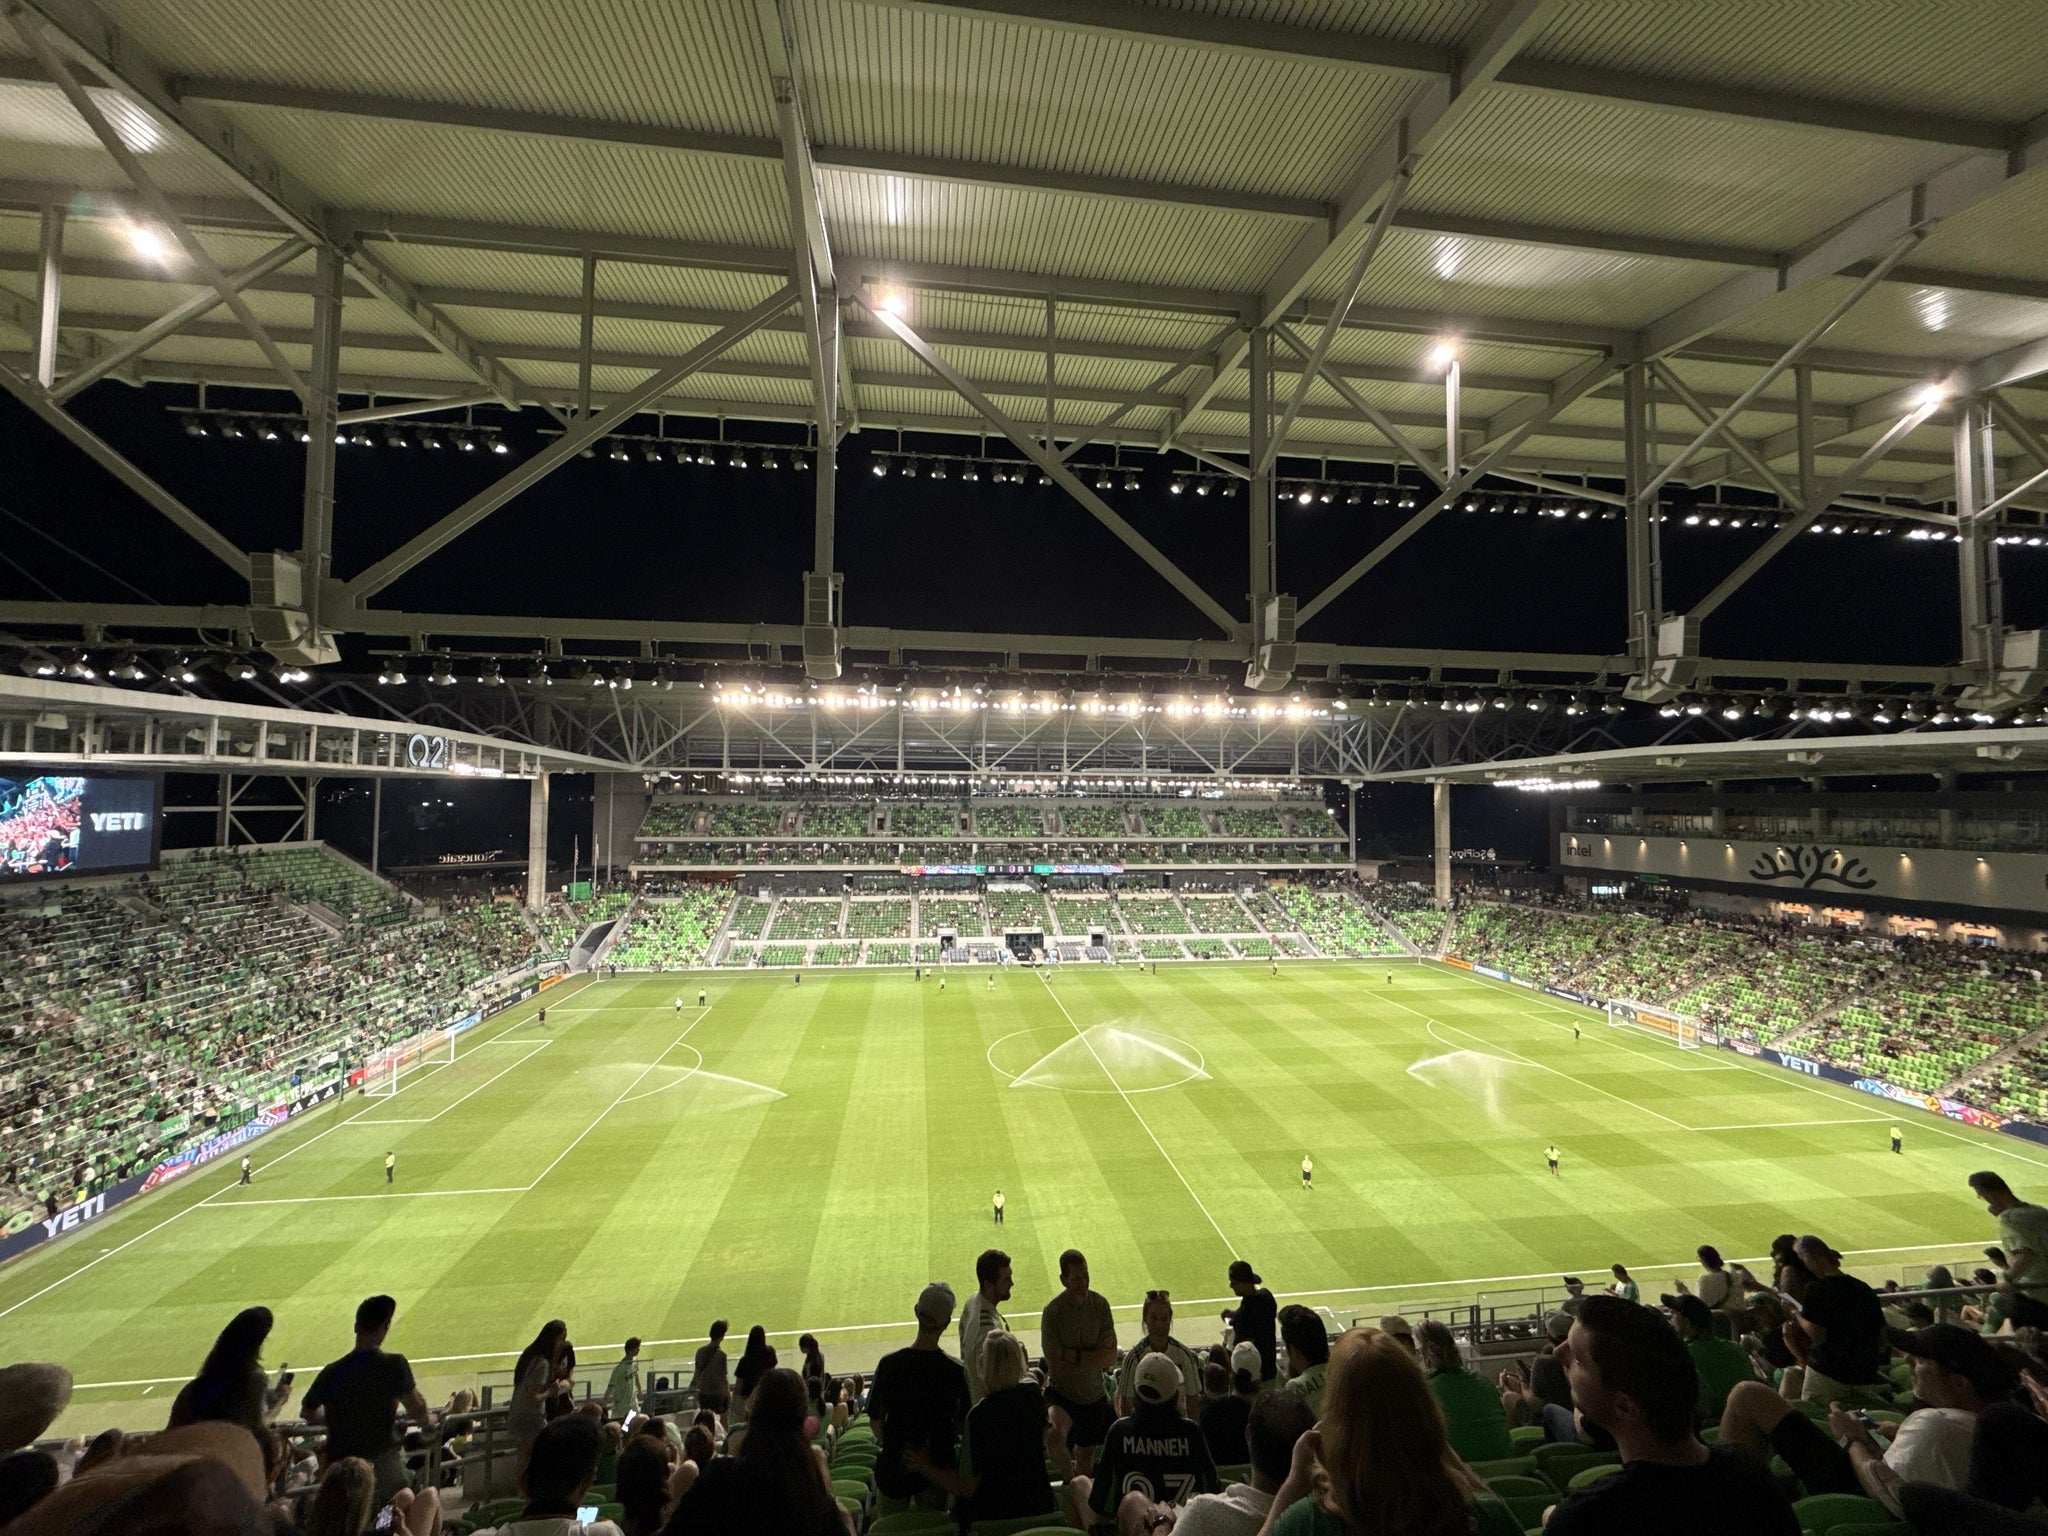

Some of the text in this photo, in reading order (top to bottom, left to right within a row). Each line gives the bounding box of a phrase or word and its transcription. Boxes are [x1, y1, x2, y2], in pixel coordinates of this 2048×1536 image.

[408, 733, 444, 769] Q2
[90, 812, 144, 832] YETI
[1567, 843, 1592, 857] intel
[520, 988, 533, 1000] YETI
[1778, 1052, 1820, 1076] YETI
[42, 1192, 106, 1238] YETI
[1122, 1435, 1190, 1457] MANNEH
